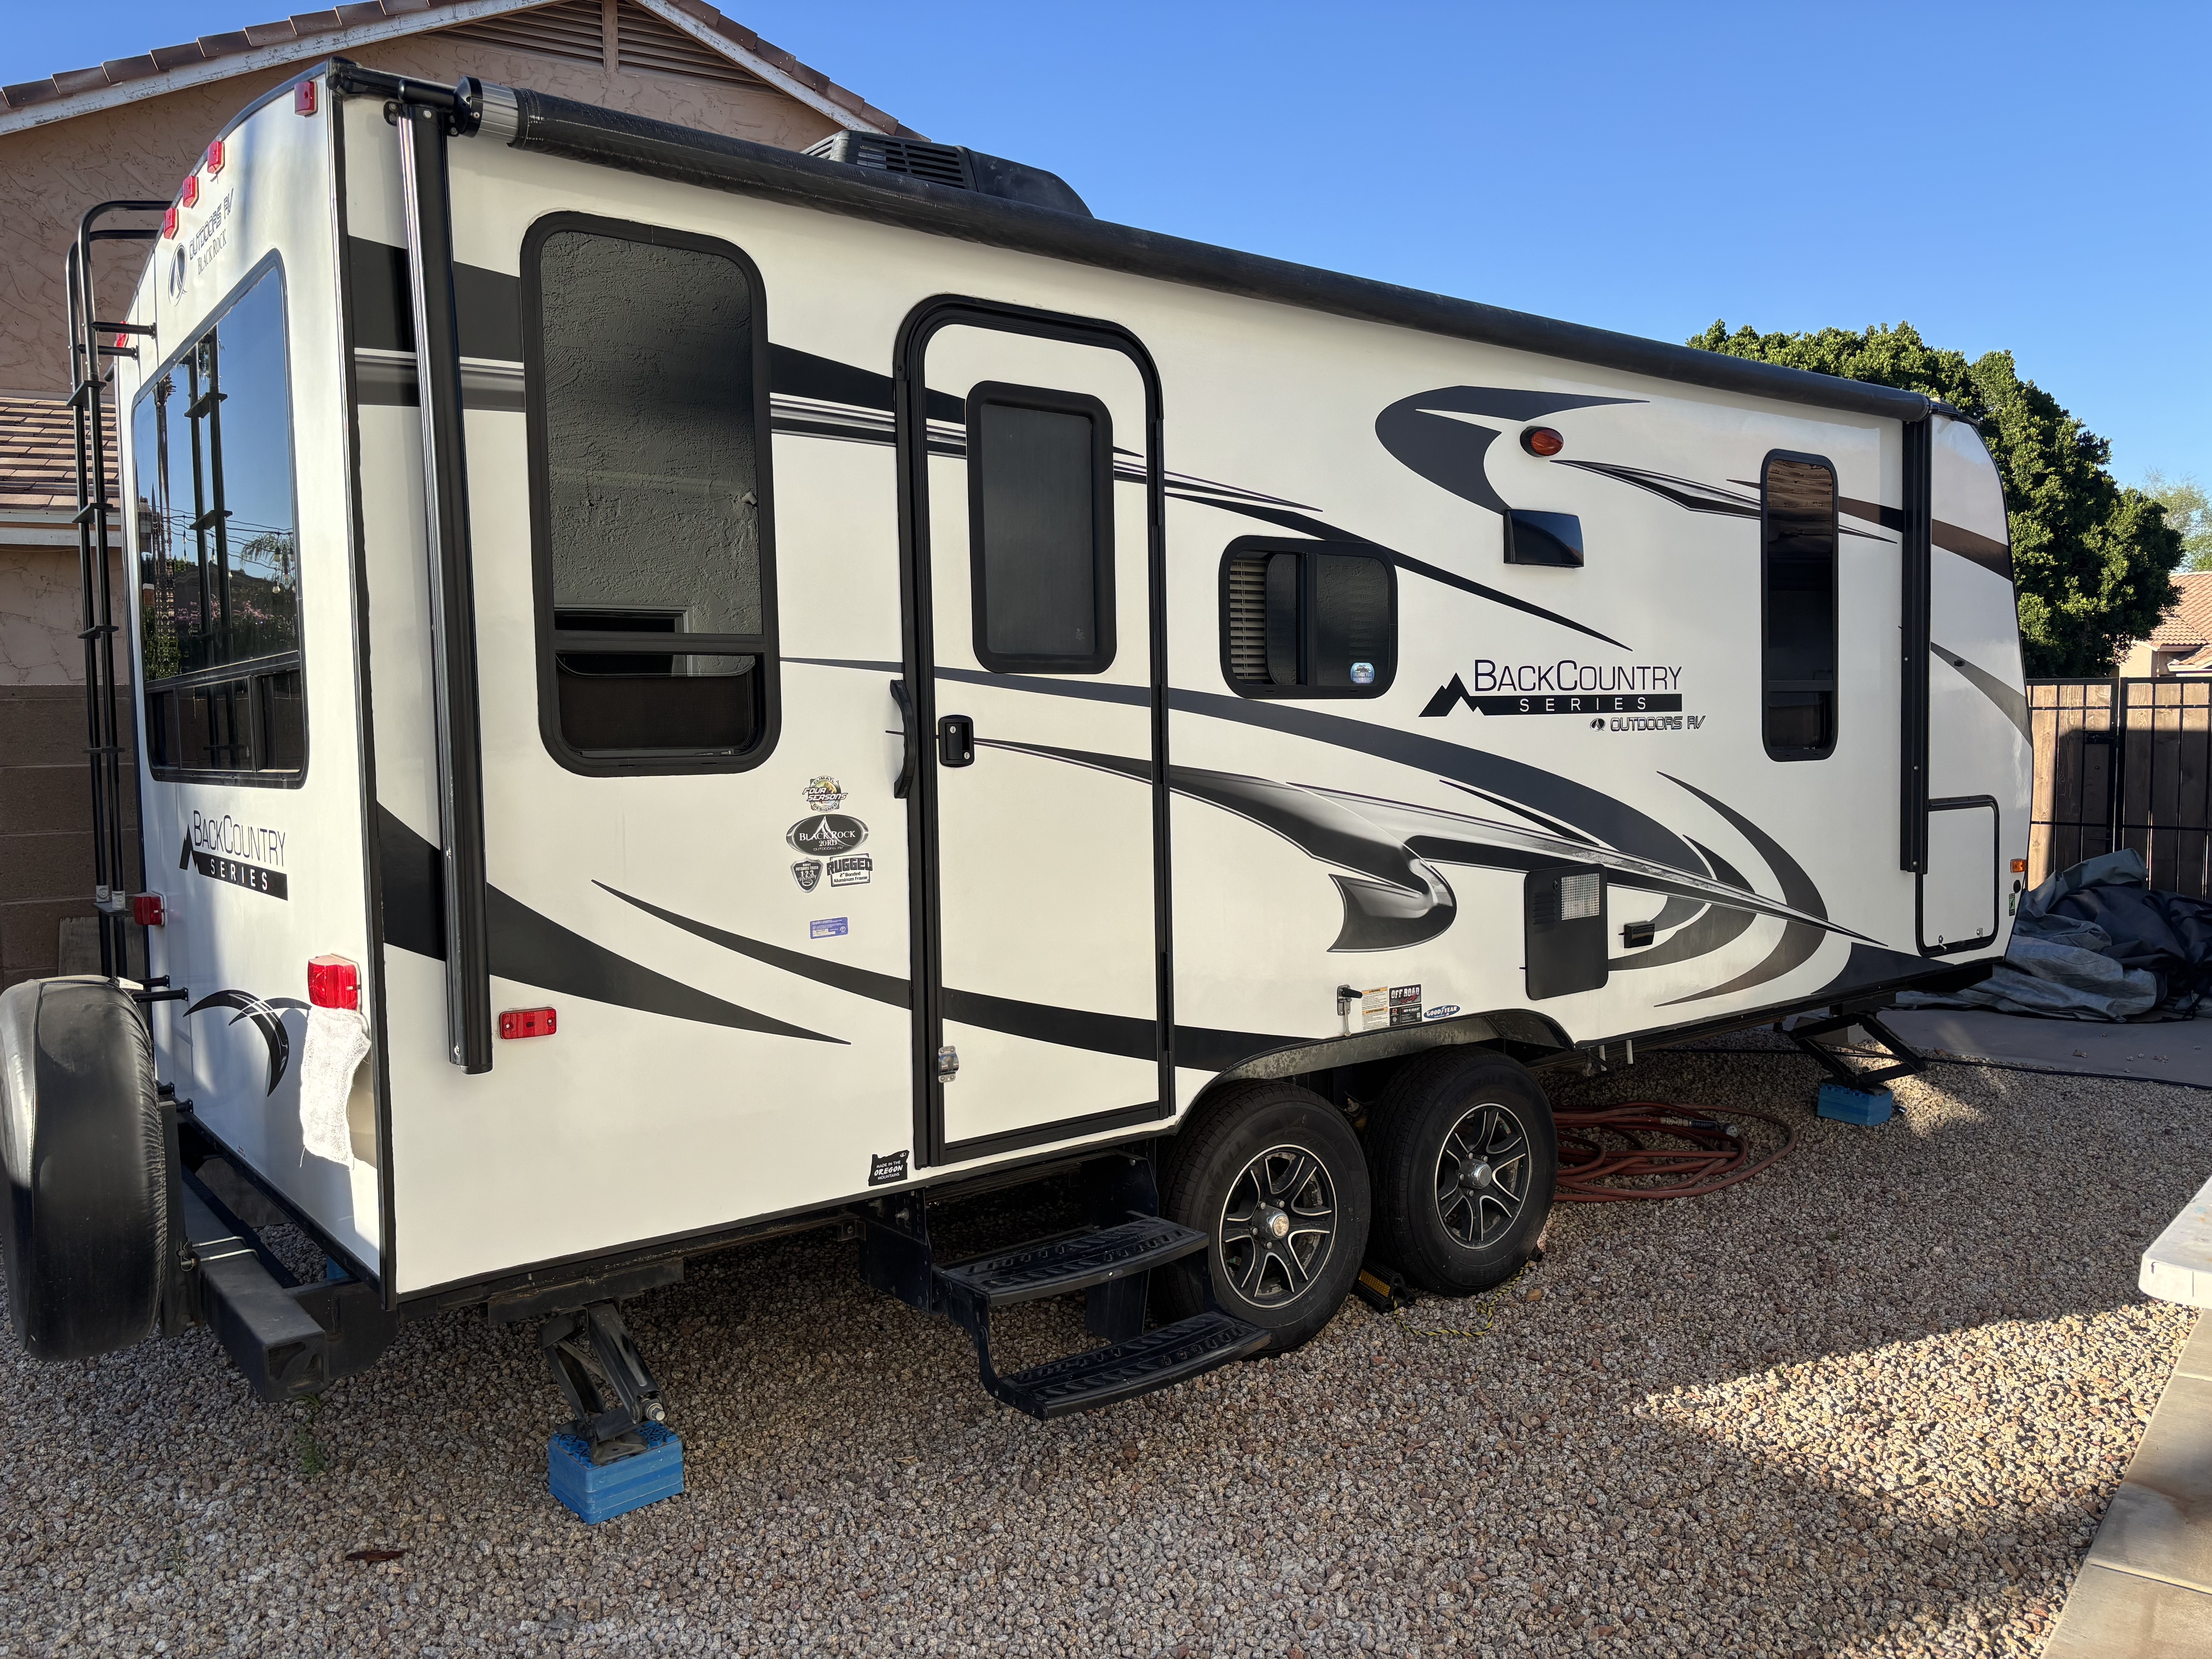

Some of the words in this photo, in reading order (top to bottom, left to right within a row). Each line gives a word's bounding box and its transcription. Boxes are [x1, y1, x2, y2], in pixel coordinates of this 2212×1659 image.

[189, 203, 222, 261] OUTDOORS
[224, 187, 234, 220] RV
[198, 245, 213, 275] BLACK
[213, 228, 227, 258] ROCK
[1519, 697, 1646, 712] SERIES
[1610, 716, 1683, 732] OUTDOORS
[1687, 715, 1706, 730] RV
[806, 793, 848, 801] SEASONS
[813, 803, 837, 812] DESIGNED
[799, 832, 830, 841] BLACK
[831, 831, 856, 839] ROCK
[826, 857, 873, 876] RUGGED
[210, 858, 268, 890] SERIES
[1391, 989, 1403, 999] OFF
[1403, 987, 1420, 997] ROAD
[1426, 1006, 1457, 1016] GOODYEAR
[874, 1164, 903, 1176] OREGON
